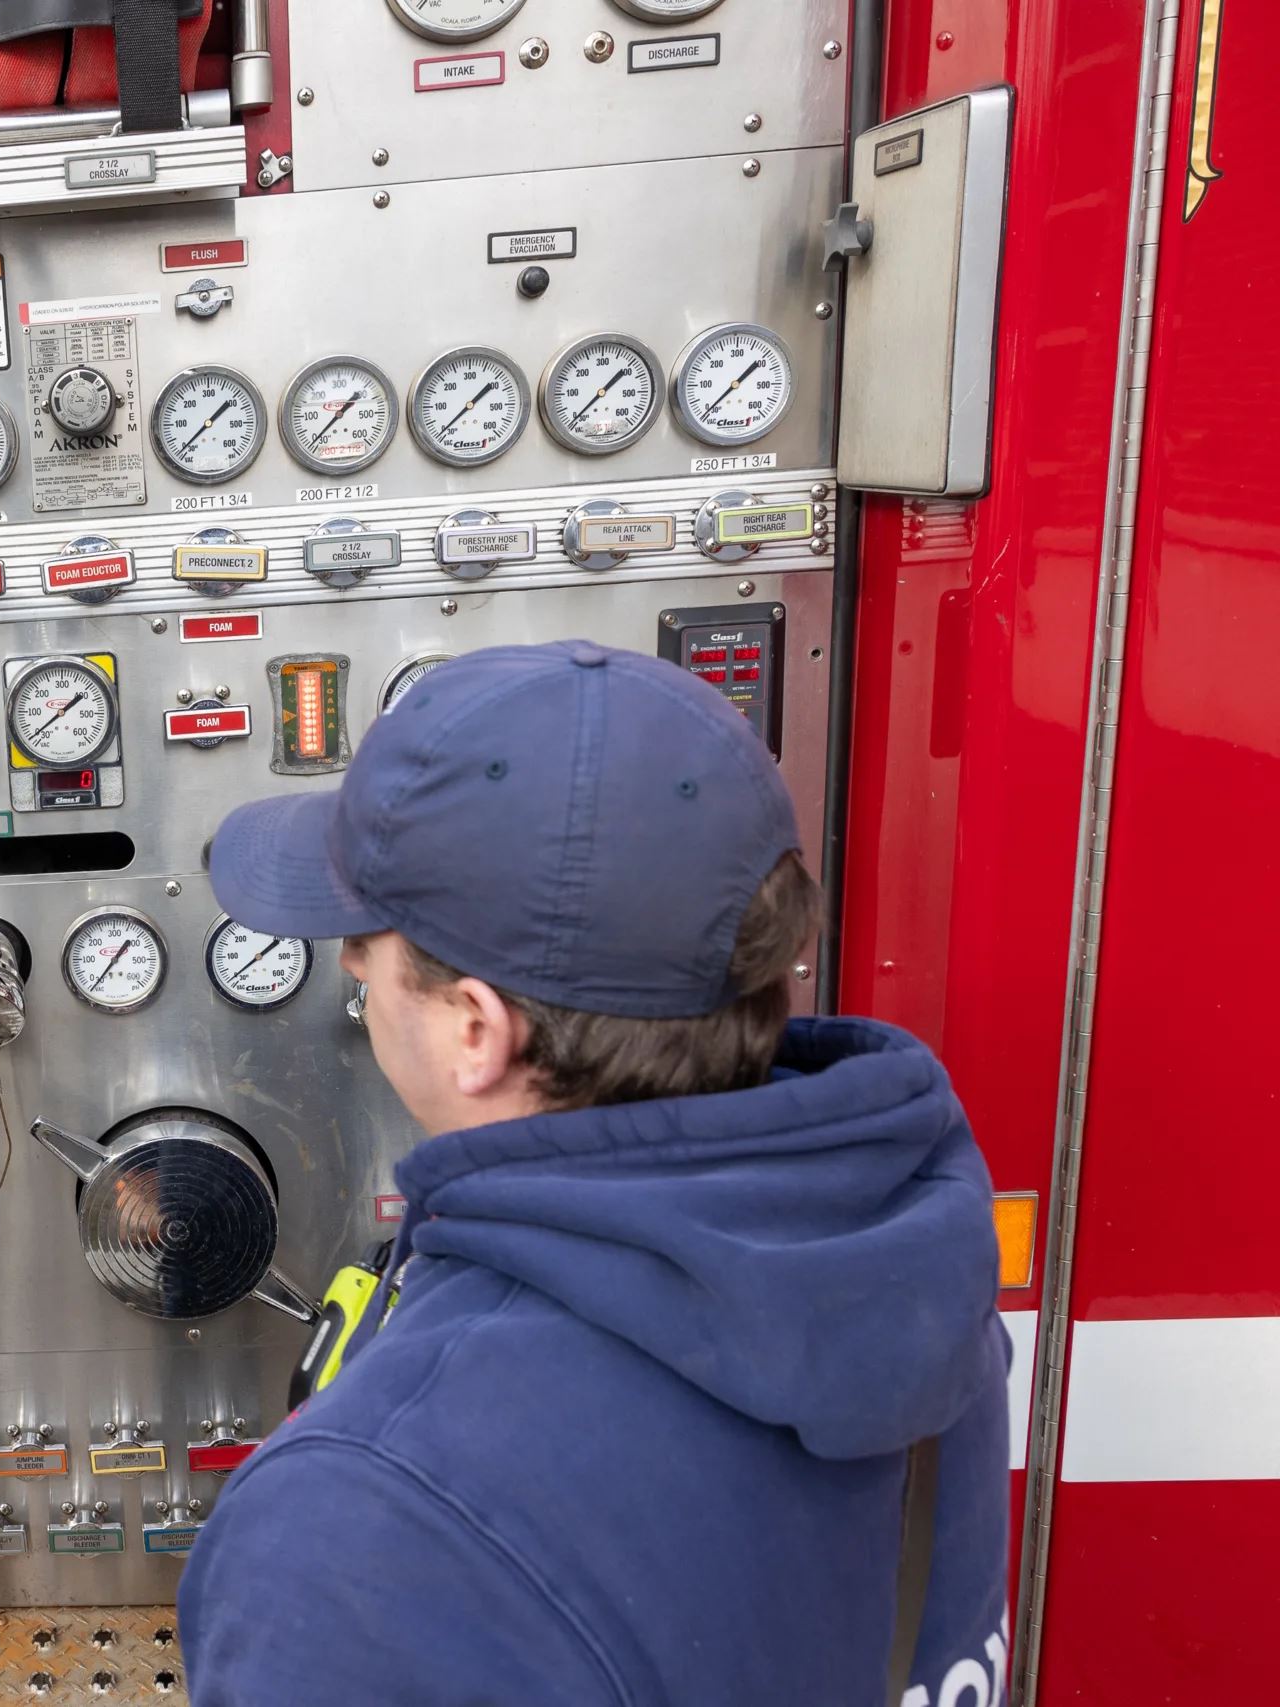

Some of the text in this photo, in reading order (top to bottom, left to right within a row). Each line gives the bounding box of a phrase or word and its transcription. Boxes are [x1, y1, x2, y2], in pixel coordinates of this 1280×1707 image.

[648, 46, 699, 60] DISCHARGE
[444, 65, 475, 77] INTAKE
[99, 159, 119, 168] 2 1/2
[89, 168, 129, 180] CROSSLAY
[510, 235, 555, 246] EMERGENCY
[191, 249, 218, 260] FLUSH
[510, 244, 555, 254] EVACUATION
[596, 357, 609, 366] 300
[463, 372, 476, 380] 300
[331, 380, 347, 388] 300
[202, 390, 215, 398] 300
[49, 435, 118, 452] AKRON
[696, 455, 770, 471] 250 FT 1 3/4
[300, 486, 373, 501] 200 FT 2 1/2
[175, 495, 247, 509] 200 FT 1 3/4
[743, 513, 787, 525] RIGHT REAR
[602, 524, 652, 534] REAR ATTACK
[744, 521, 786, 533] DISCHARGE
[458, 534, 518, 546] FORESTRY HOSE
[619, 533, 635, 543] LINE
[467, 542, 509, 553] DISCHARGE
[332, 551, 371, 561] CROSSLAY
[189, 558, 245, 568] PRECONNECT
[56, 564, 121, 580] FOAM EDUCTOR
[209, 623, 232, 632] FOAM
[197, 718, 219, 727] FOAM
[81, 771, 92, 788] 0
[108, 929, 121, 938] 300
